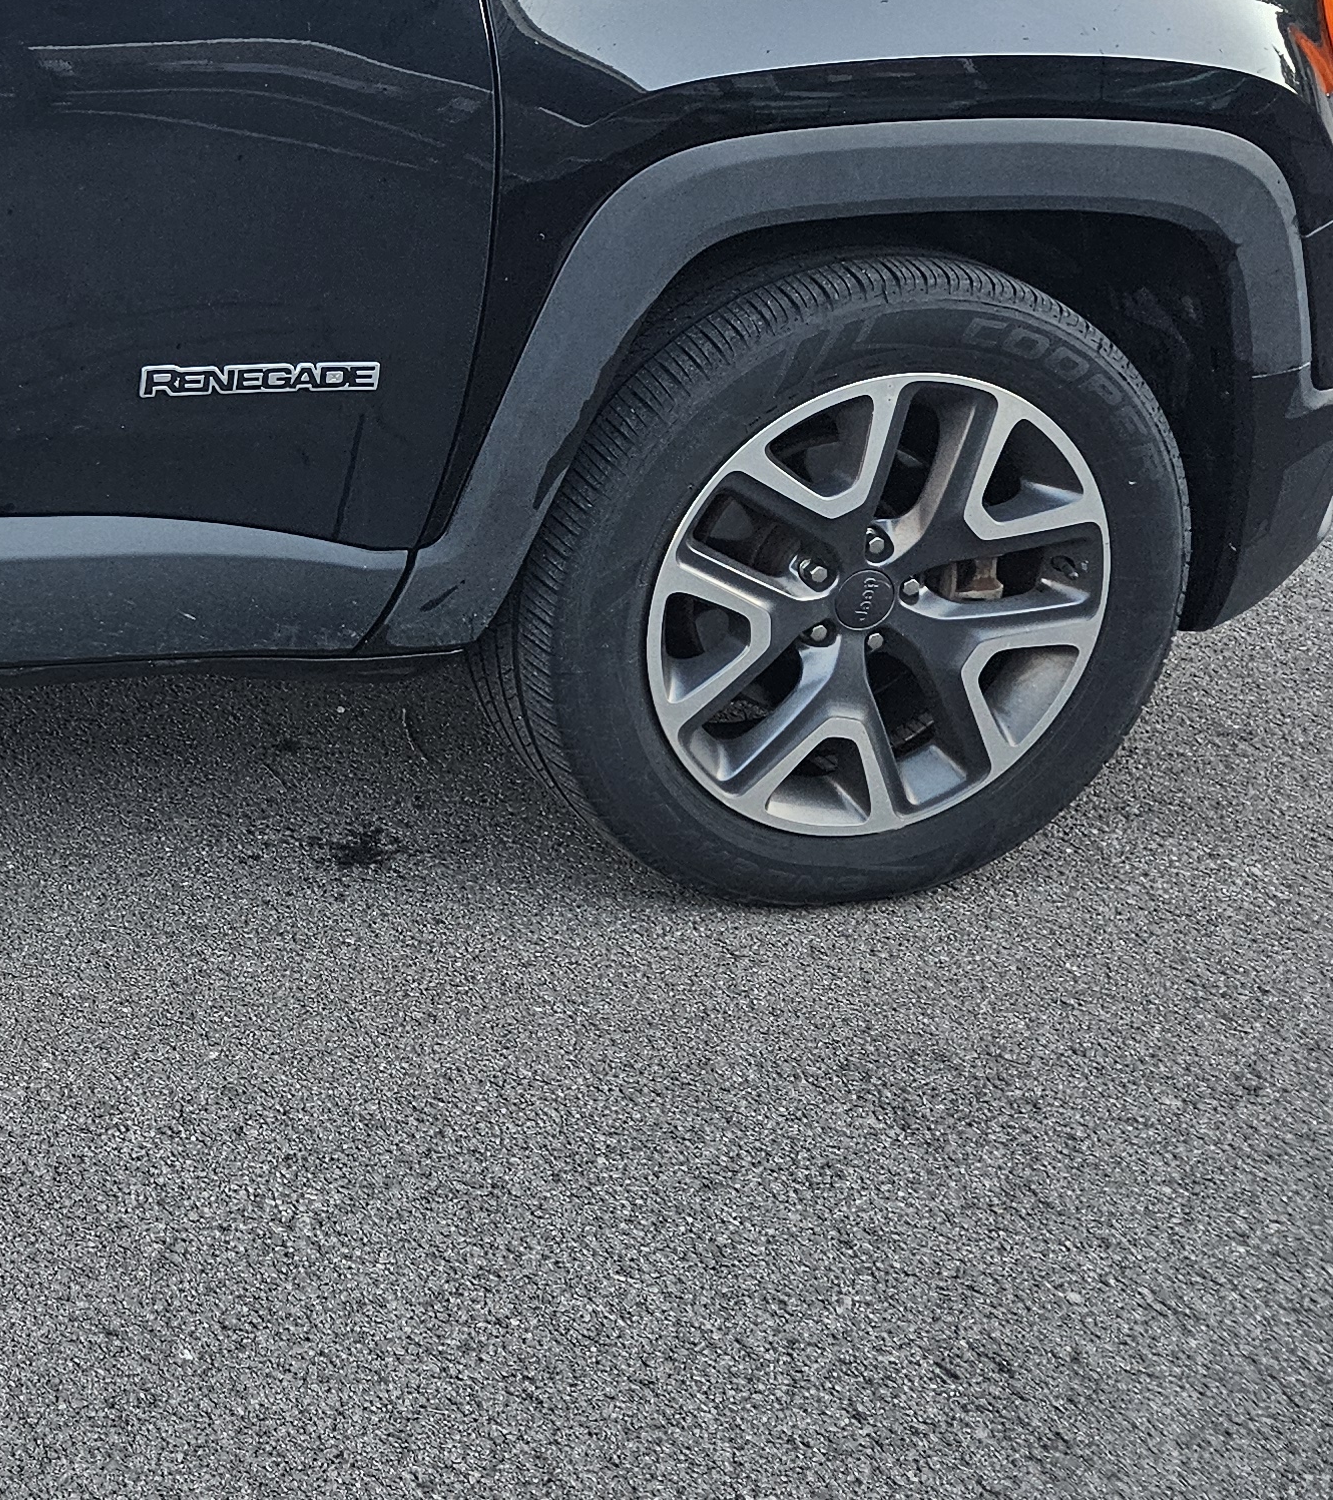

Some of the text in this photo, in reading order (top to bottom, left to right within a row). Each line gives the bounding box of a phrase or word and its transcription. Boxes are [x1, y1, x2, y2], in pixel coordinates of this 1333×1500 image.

[140, 362, 380, 398] RENEGADE
[961, 317, 1171, 482] COOPER
[855, 577, 880, 621] Jeep
